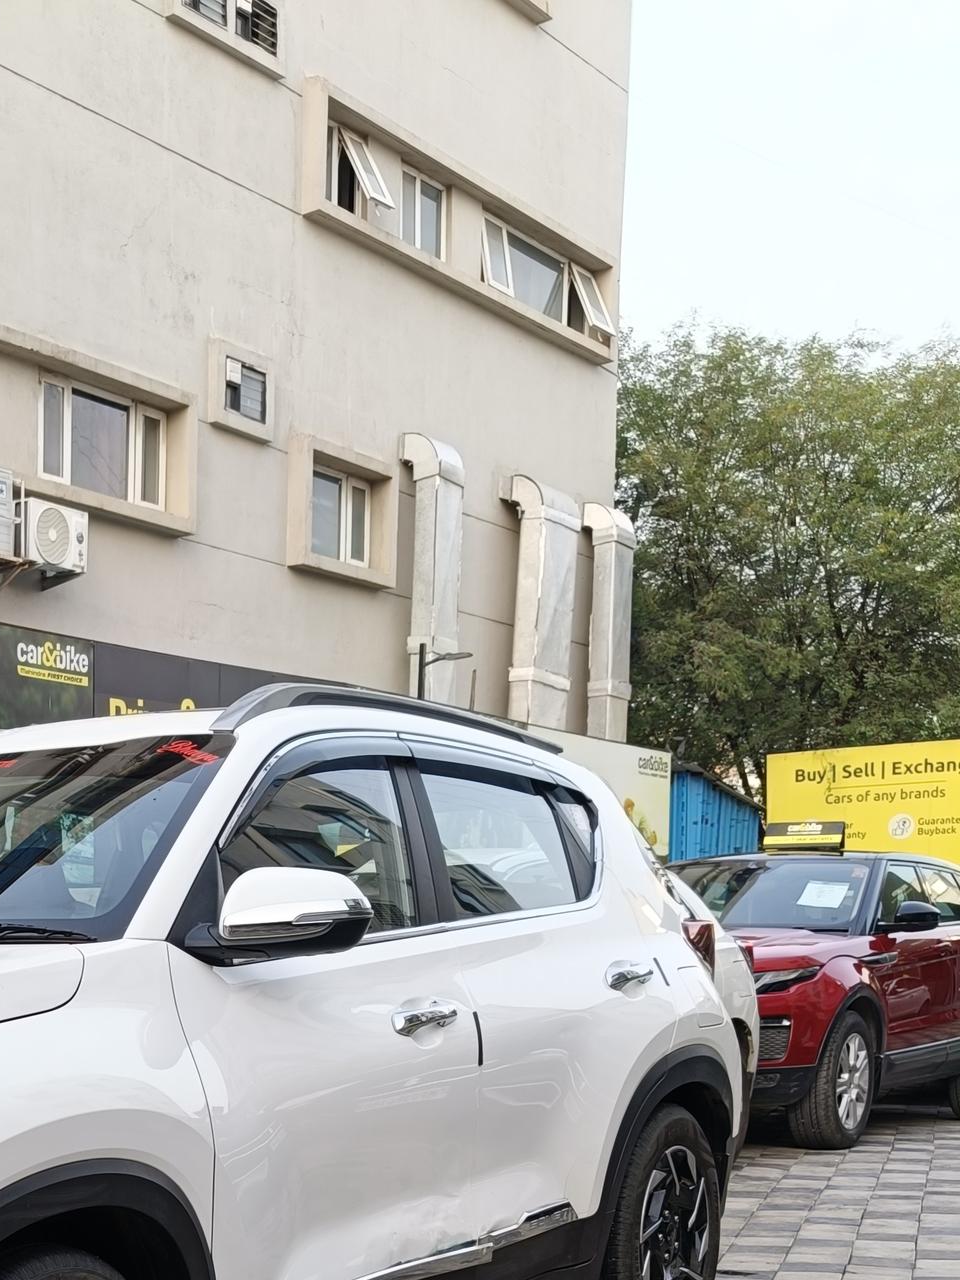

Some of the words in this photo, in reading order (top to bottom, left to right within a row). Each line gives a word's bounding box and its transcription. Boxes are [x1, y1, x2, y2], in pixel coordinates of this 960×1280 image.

[16, 641, 89, 673] car&bike
[48, 673, 63, 681] FIRST
[64, 675, 83, 684] CHOICE
[795, 768, 827, 784] Buy
[842, 761, 876, 779] Sell
[825, 792, 853, 805] Cars
[856, 790, 871, 803] of
[873, 791, 897, 804] any
[900, 786, 946, 800] brands
[917, 825, 957, 837] Buyback
